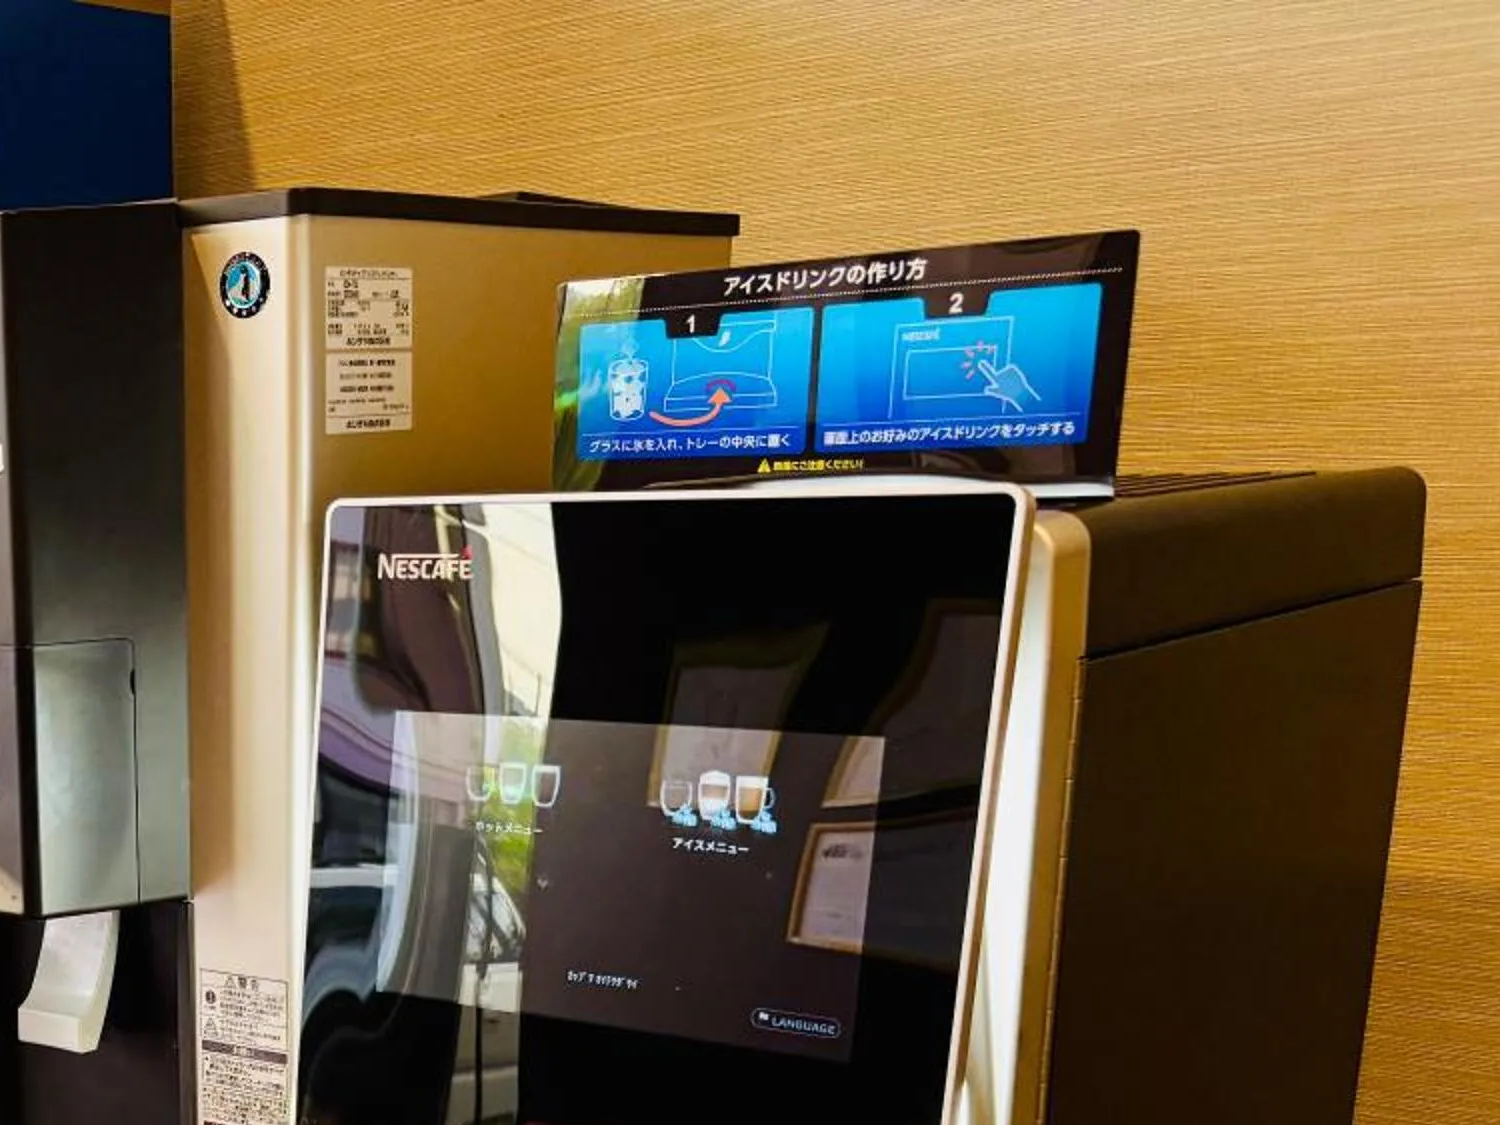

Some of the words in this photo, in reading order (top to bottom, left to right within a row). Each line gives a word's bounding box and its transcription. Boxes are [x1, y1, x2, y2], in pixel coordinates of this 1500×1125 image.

[723, 258, 928, 296] アイスドリンクの作り方
[949, 292, 964, 313] 2
[686, 315, 696, 333] 1
[589, 433, 791, 453] グラスに氷を入れ、トレーの中央に置く
[823, 421, 1075, 446] 画面上のお好みのアイスドリンクをタッチする
[672, 837, 750, 855] アイスメニュー
[771, 1016, 835, 1035] LANGUAGE
